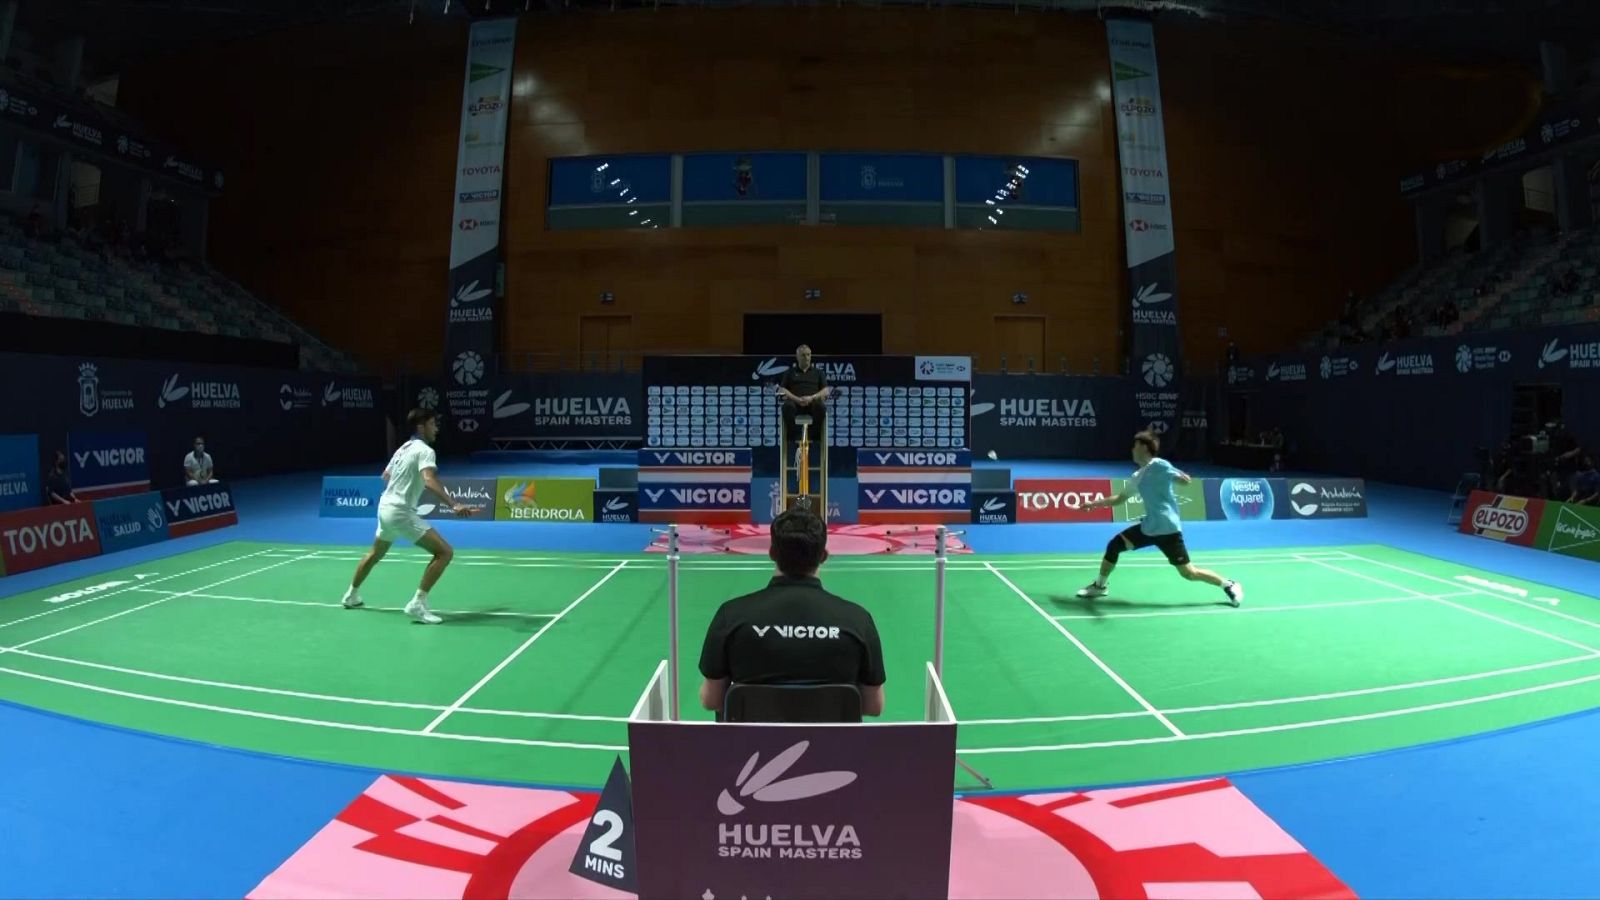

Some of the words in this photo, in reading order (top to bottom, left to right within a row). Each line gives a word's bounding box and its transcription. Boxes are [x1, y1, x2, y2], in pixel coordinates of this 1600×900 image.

[462, 166, 500, 175] TOYOTA
[1124, 167, 1163, 177] TOYOTA
[450, 308, 493, 318] HUELVA
[1132, 309, 1176, 320] HUELVA
[1570, 343, 1600, 359] HUE
[1396, 354, 1433, 368] HUELVA
[795, 363, 856, 374] ELVA
[191, 382, 240, 398] HUELVA
[342, 387, 373, 400] HUELVA
[102, 398, 134, 409] HUELVA
[535, 397, 631, 415] HUELVA
[1000, 398, 1096, 416] HUELVA
[535, 416, 570, 425] SPAIN
[575, 416, 632, 425] MASTERS
[1000, 417, 1037, 426] SPAIN
[1041, 418, 1097, 427] MASTERS
[1182, 418, 1208, 428] ELVA
[94, 447, 145, 467] VICTOR
[674, 452, 735, 464] VICTOR
[895, 452, 957, 465] VICTOR
[183, 491, 231, 514] VICTOR
[670, 488, 745, 504] VICTOR
[890, 489, 966, 504] VICTOR
[1018, 492, 1106, 509] TOYOTA
[511, 508, 585, 520] IBERDROLA
[602, 513, 630, 521] HUELVA
[979, 513, 1007, 522] HUELVA
[4, 518, 94, 555] TOYOTA
[773, 625, 841, 639] VICTOR
[590, 809, 624, 861] 2
[718, 823, 861, 847] HUELVA
[718, 846, 772, 859] SPAIN
[779, 847, 863, 859] MASTERS
[585, 854, 625, 879] MINS
